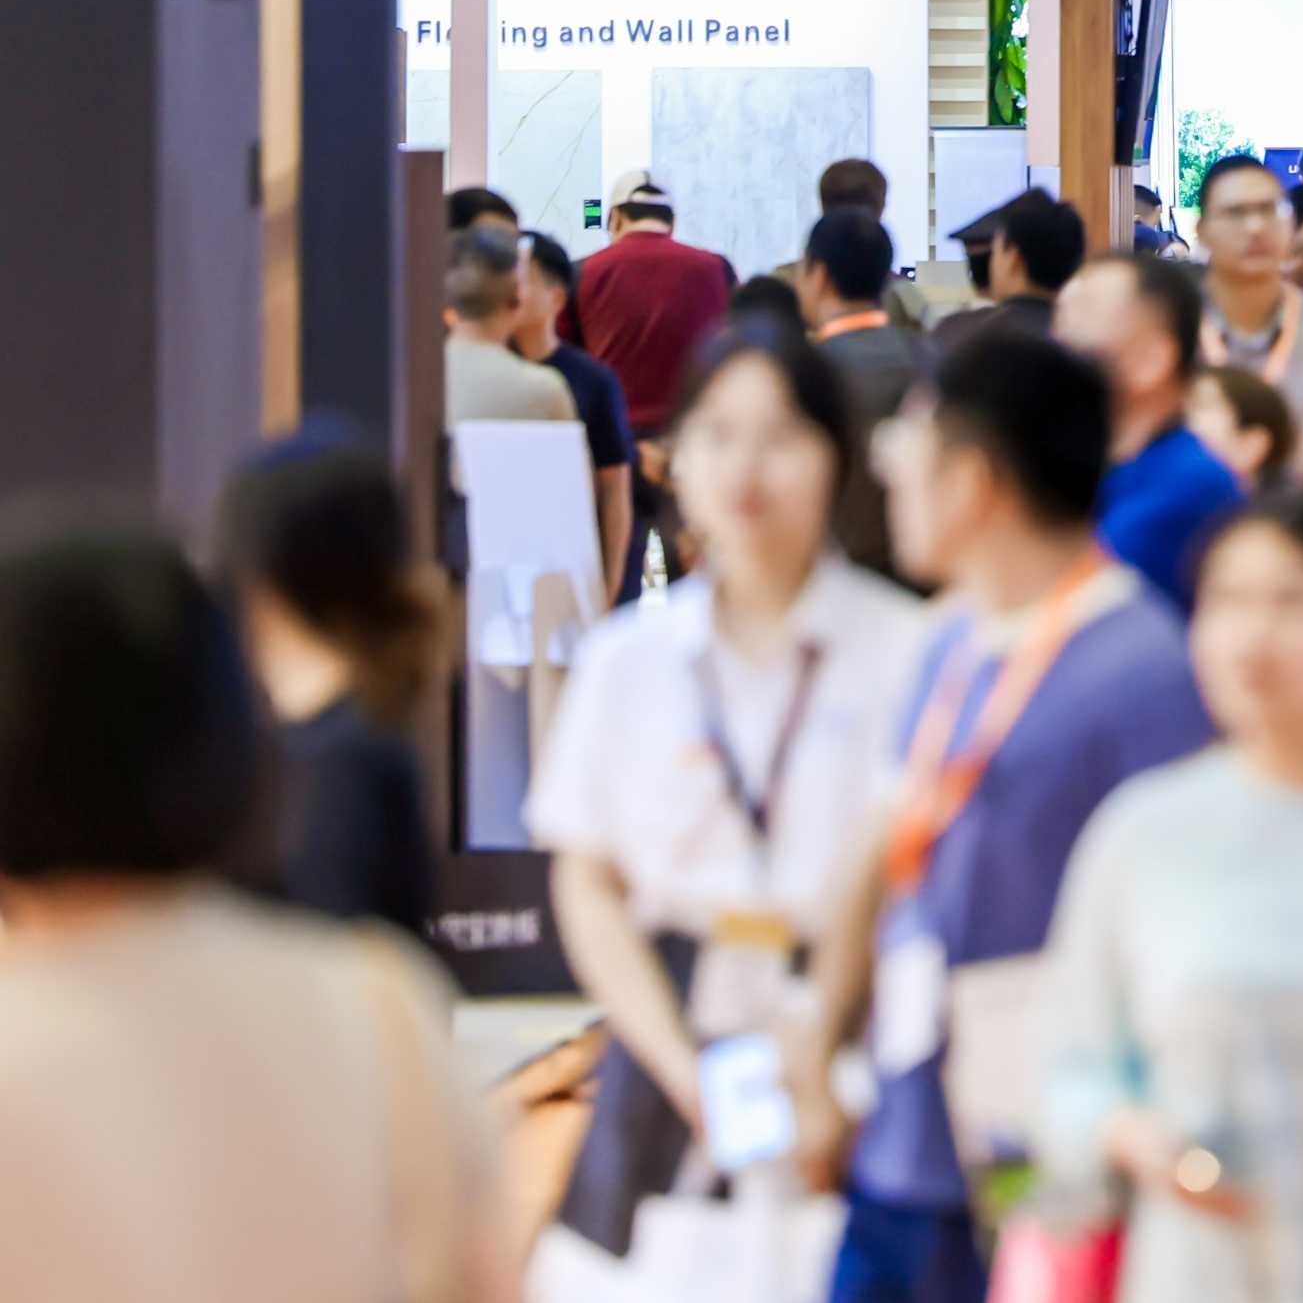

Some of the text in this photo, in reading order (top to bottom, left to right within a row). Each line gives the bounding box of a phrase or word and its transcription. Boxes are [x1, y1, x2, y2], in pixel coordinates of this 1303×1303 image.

[559, 20, 615, 43] and
[626, 19, 694, 43] Wall
[704, 19, 791, 43] Panel
